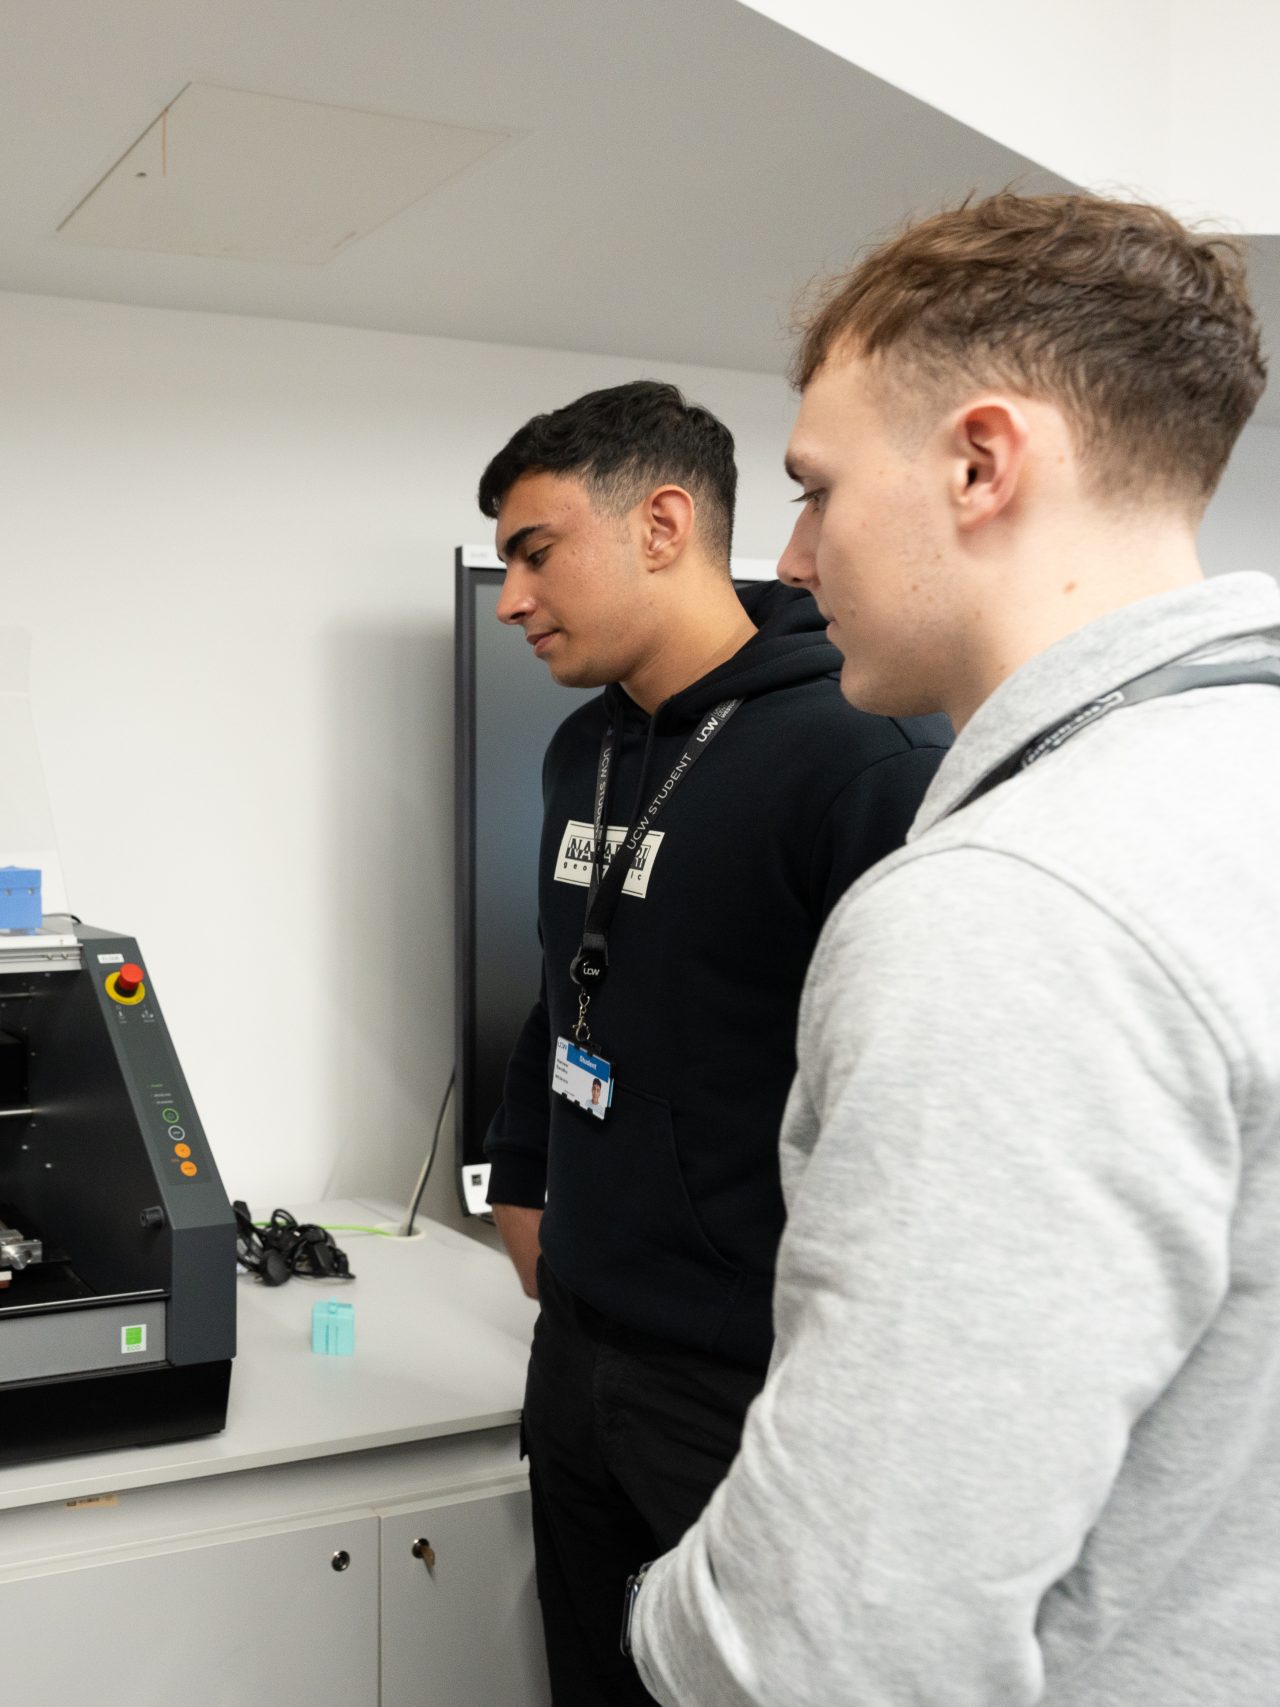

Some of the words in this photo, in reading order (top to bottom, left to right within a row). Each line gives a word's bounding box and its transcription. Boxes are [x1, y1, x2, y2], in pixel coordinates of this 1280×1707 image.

[696, 716, 719, 743] UCW
[600, 747, 612, 778] UCW
[626, 816, 650, 850] UCW
[648, 752, 693, 815] STUDENT
[583, 967, 600, 976] UCW
[579, 1055, 598, 1071] Student
